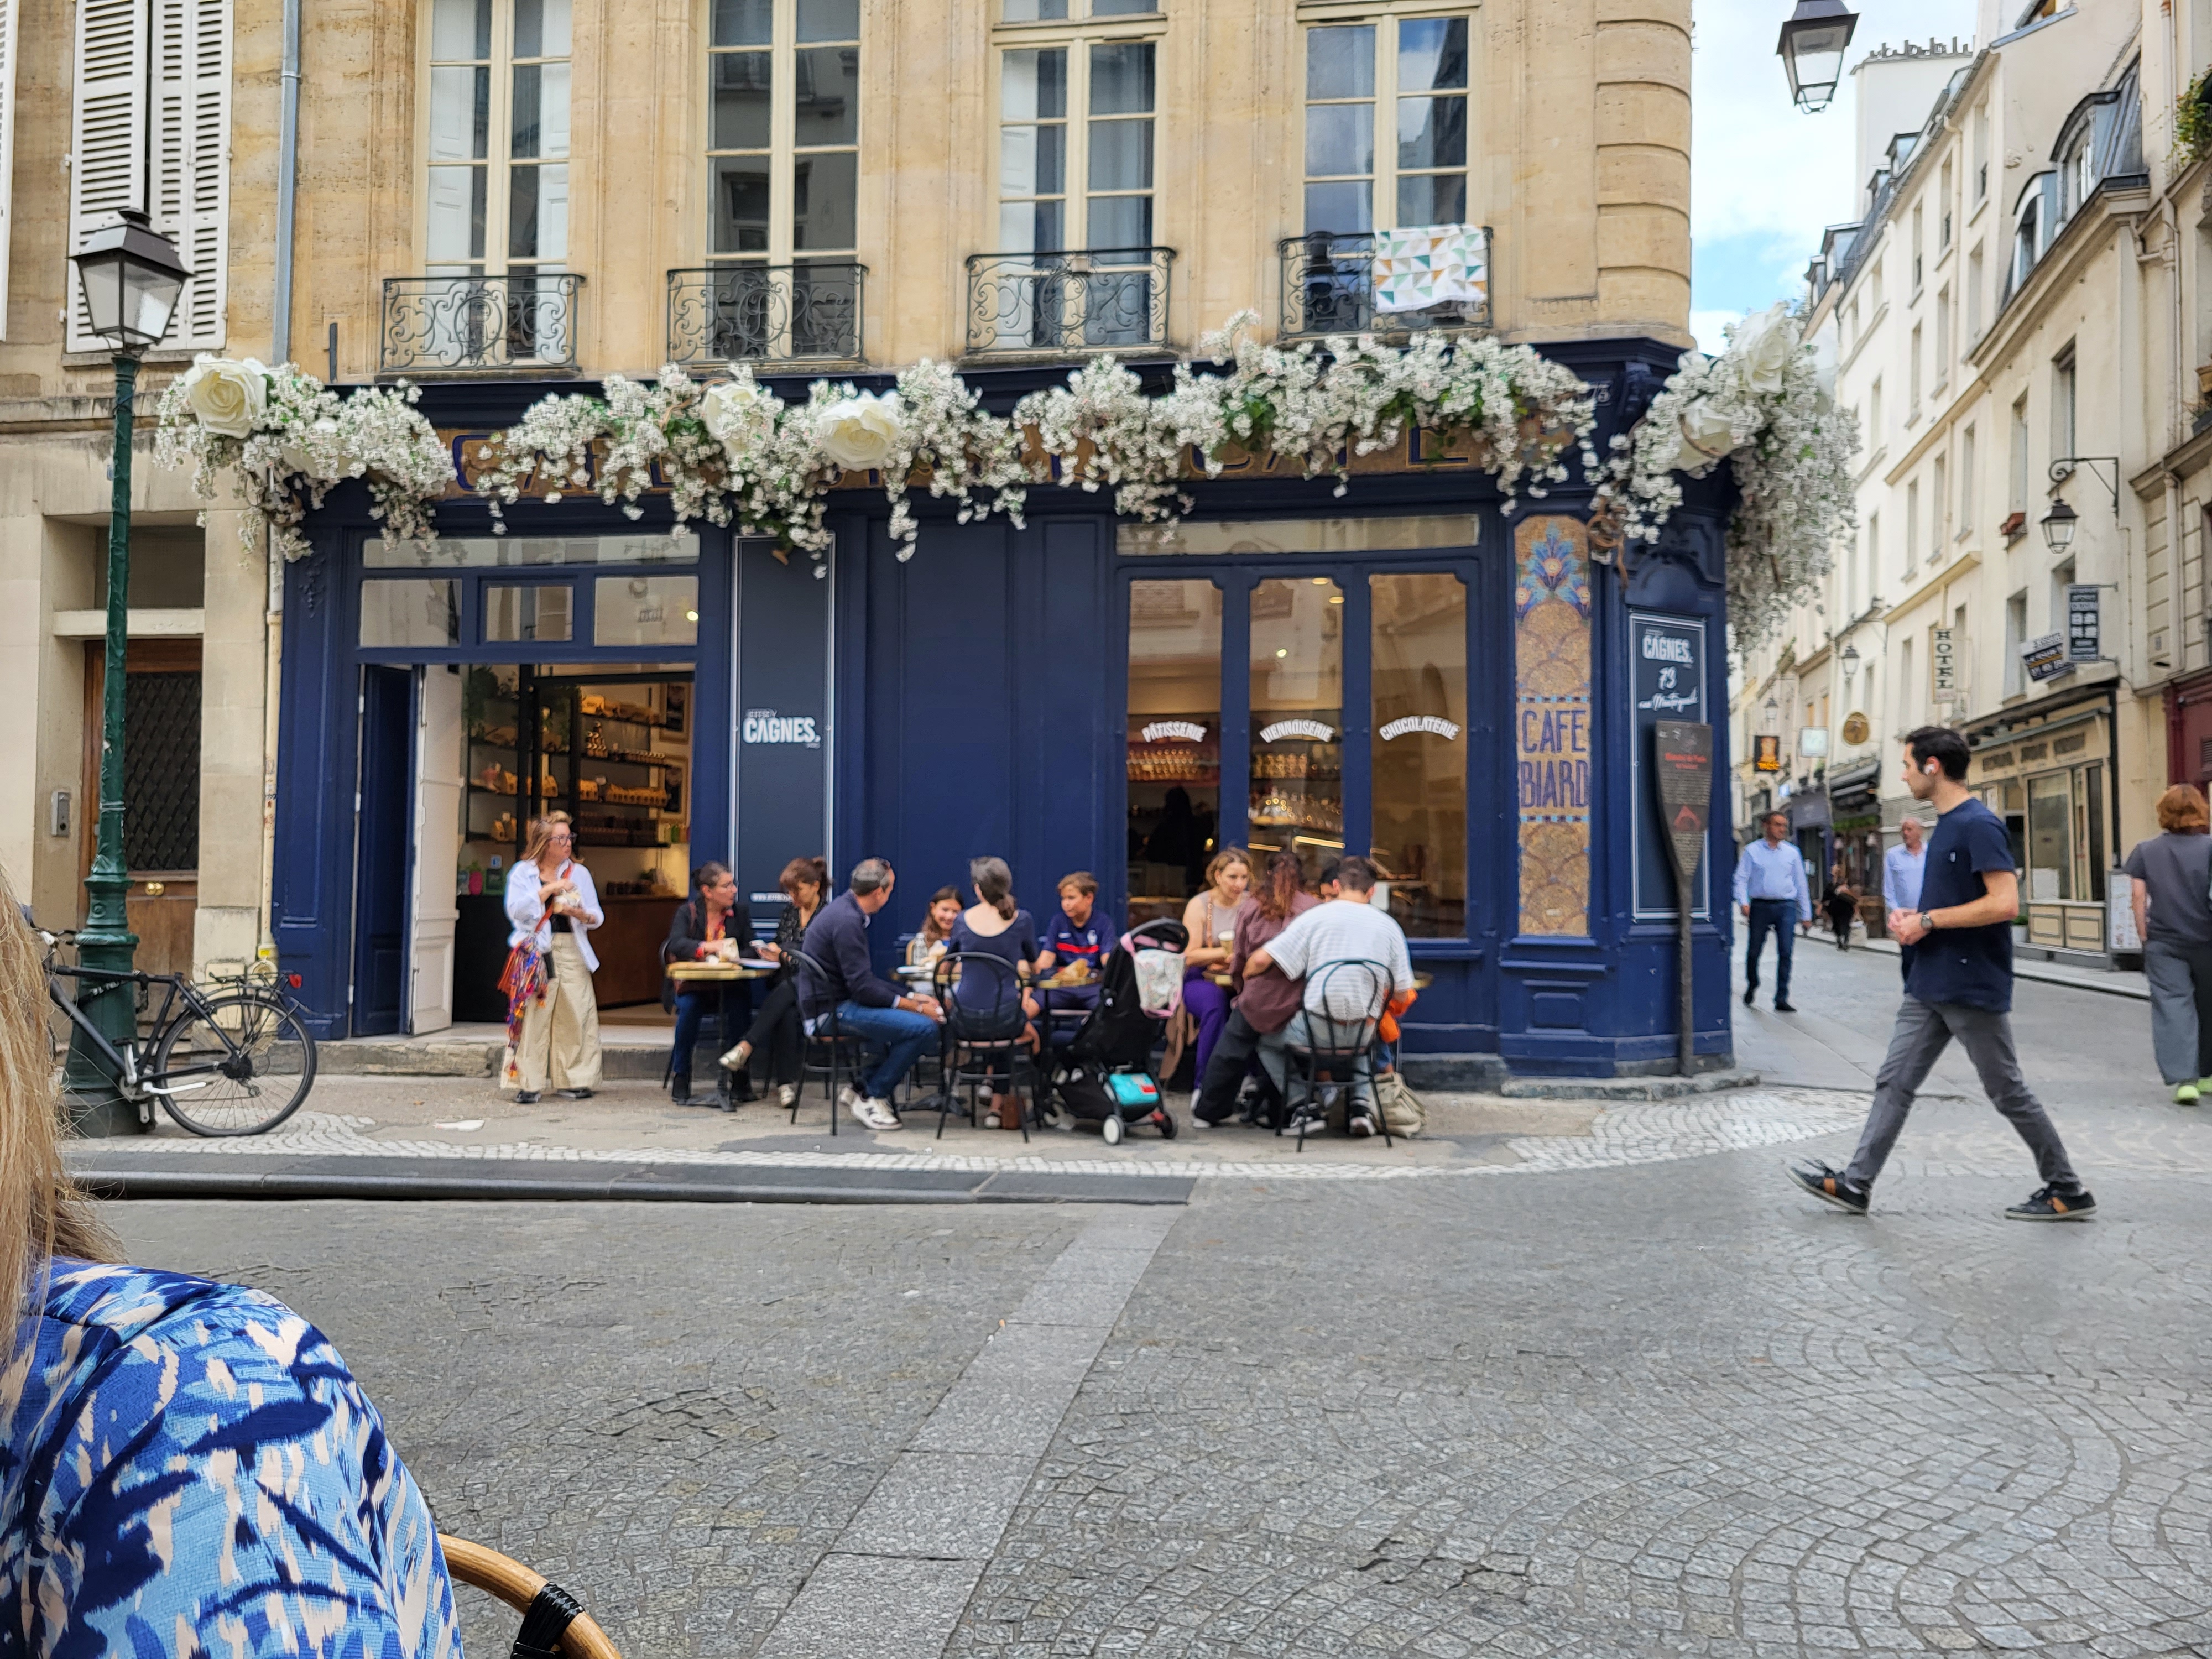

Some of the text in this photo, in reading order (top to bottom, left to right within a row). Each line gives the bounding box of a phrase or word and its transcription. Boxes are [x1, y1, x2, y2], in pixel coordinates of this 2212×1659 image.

[1935, 630, 1954, 690] HOTEL
[1260, 719, 1336, 743] VIENNOISERIE
[1379, 715, 1462, 741] CHOCOLATERIE
[1522, 709, 1587, 753] CAFE
[1521, 760, 1589, 808] BIARD
